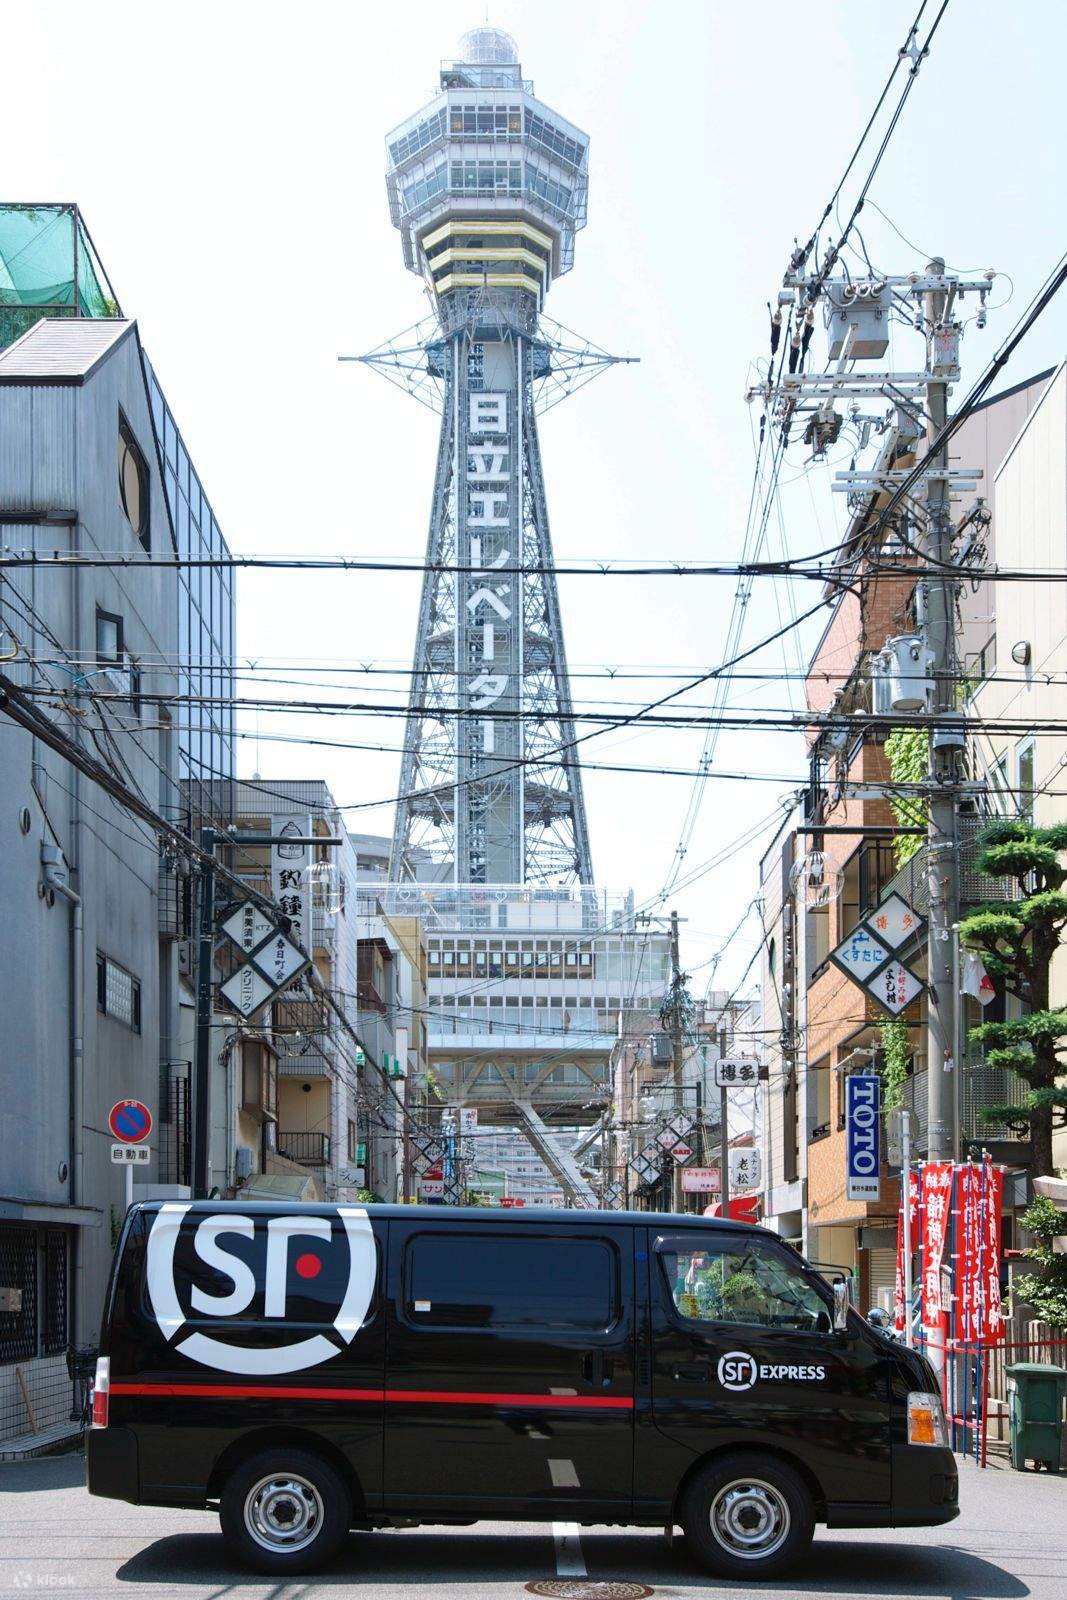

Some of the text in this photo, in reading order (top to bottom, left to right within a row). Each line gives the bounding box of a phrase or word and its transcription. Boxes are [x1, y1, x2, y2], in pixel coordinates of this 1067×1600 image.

[466, 392, 511, 754] 日立エレベーター
[274, 938, 286, 980] 春日町会
[242, 969, 251, 1010] クリニック
[853, 1082, 876, 1175] TOTO
[113, 1149, 148, 1160] 自動車
[736, 1157, 749, 1185] 老松
[750, 1151, 758, 1178] スナック
[760, 1364, 826, 1380] EXPRESS
